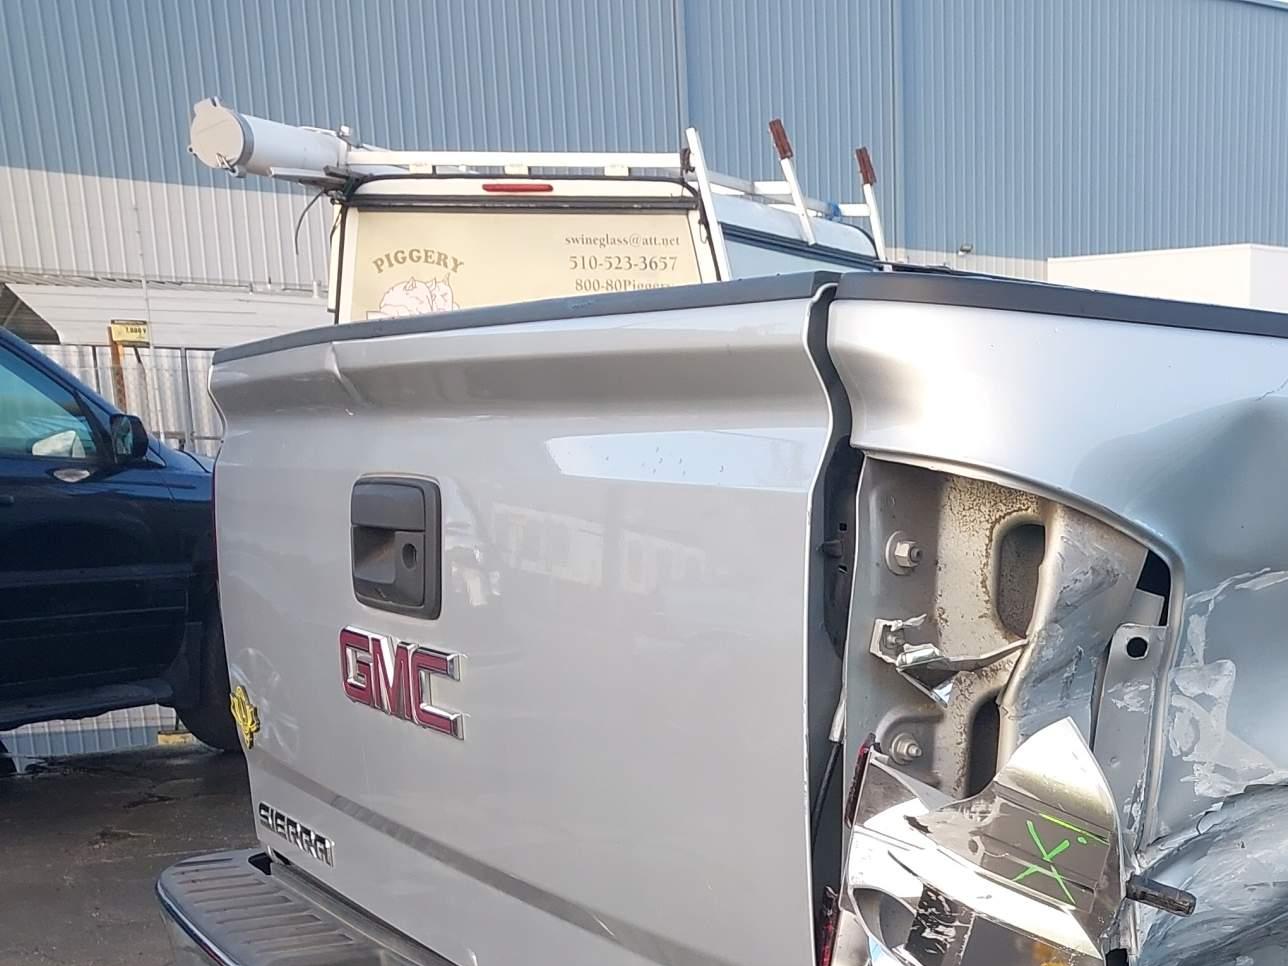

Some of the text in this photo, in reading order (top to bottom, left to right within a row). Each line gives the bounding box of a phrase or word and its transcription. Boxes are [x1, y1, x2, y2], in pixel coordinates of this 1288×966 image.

[565, 233, 680, 248] swineglass@att.net
[372, 248, 465, 274] PIGGERY
[568, 255, 678, 271] 510-523-3657
[339, 625, 466, 741] GMC
[258, 800, 335, 868] SIERRA
